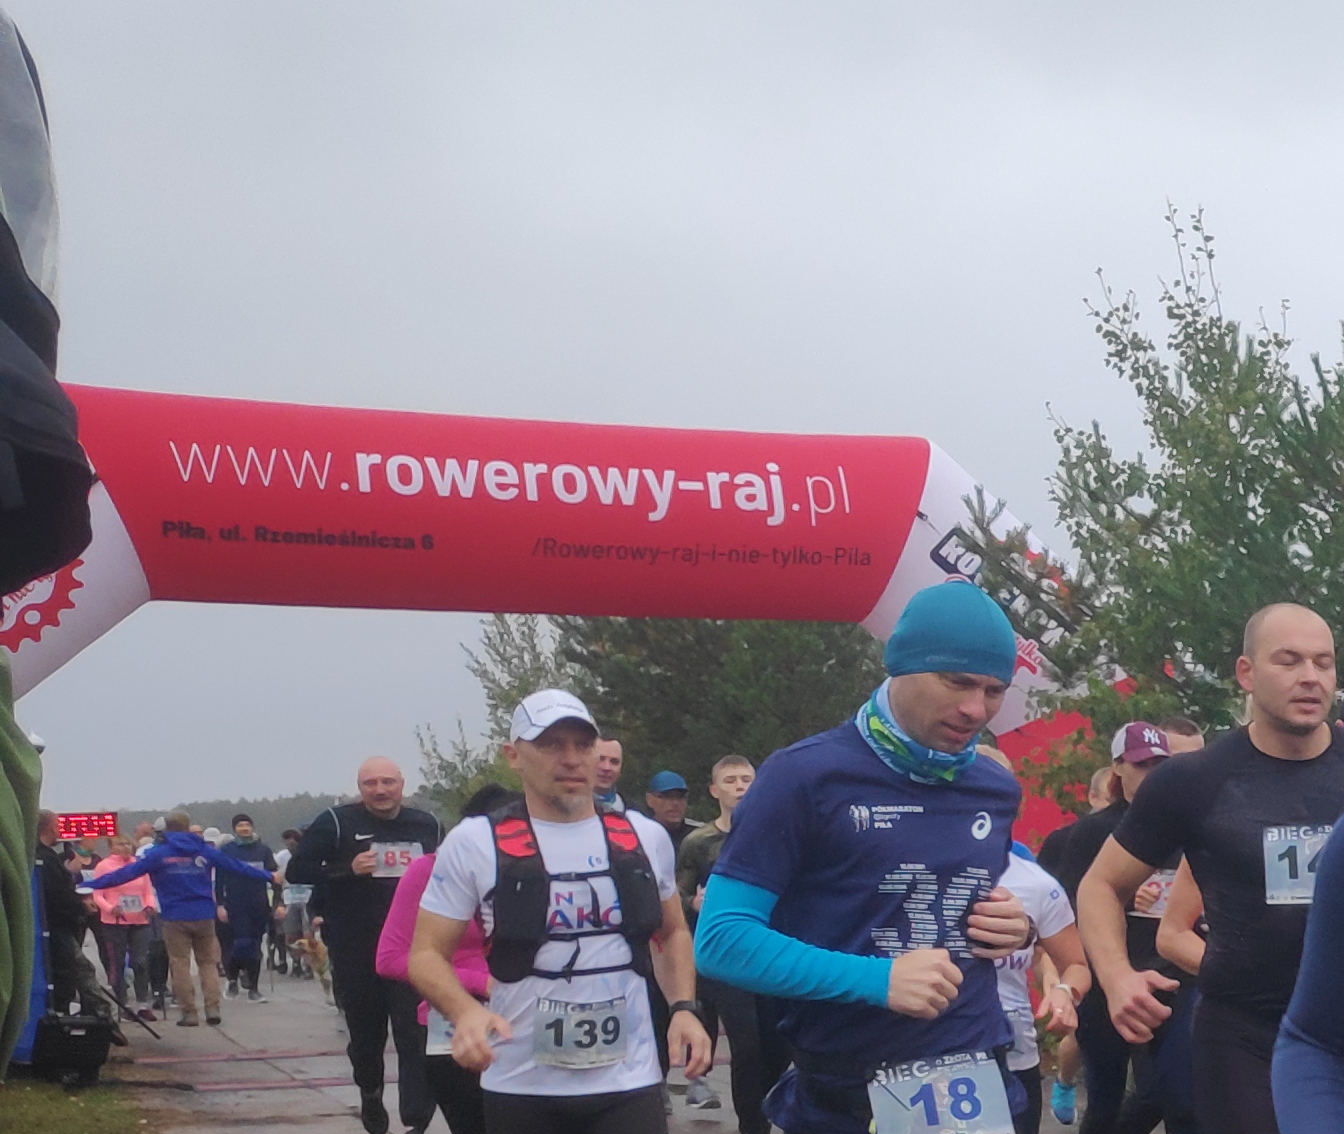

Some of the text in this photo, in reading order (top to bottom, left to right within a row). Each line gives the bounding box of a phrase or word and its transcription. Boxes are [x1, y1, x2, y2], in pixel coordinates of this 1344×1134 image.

[168, 440, 851, 527] www.rowerowy-raj.pl
[384, 851, 412, 867] 85
[545, 1016, 620, 1048] 139
[909, 1077, 982, 1127] 18
